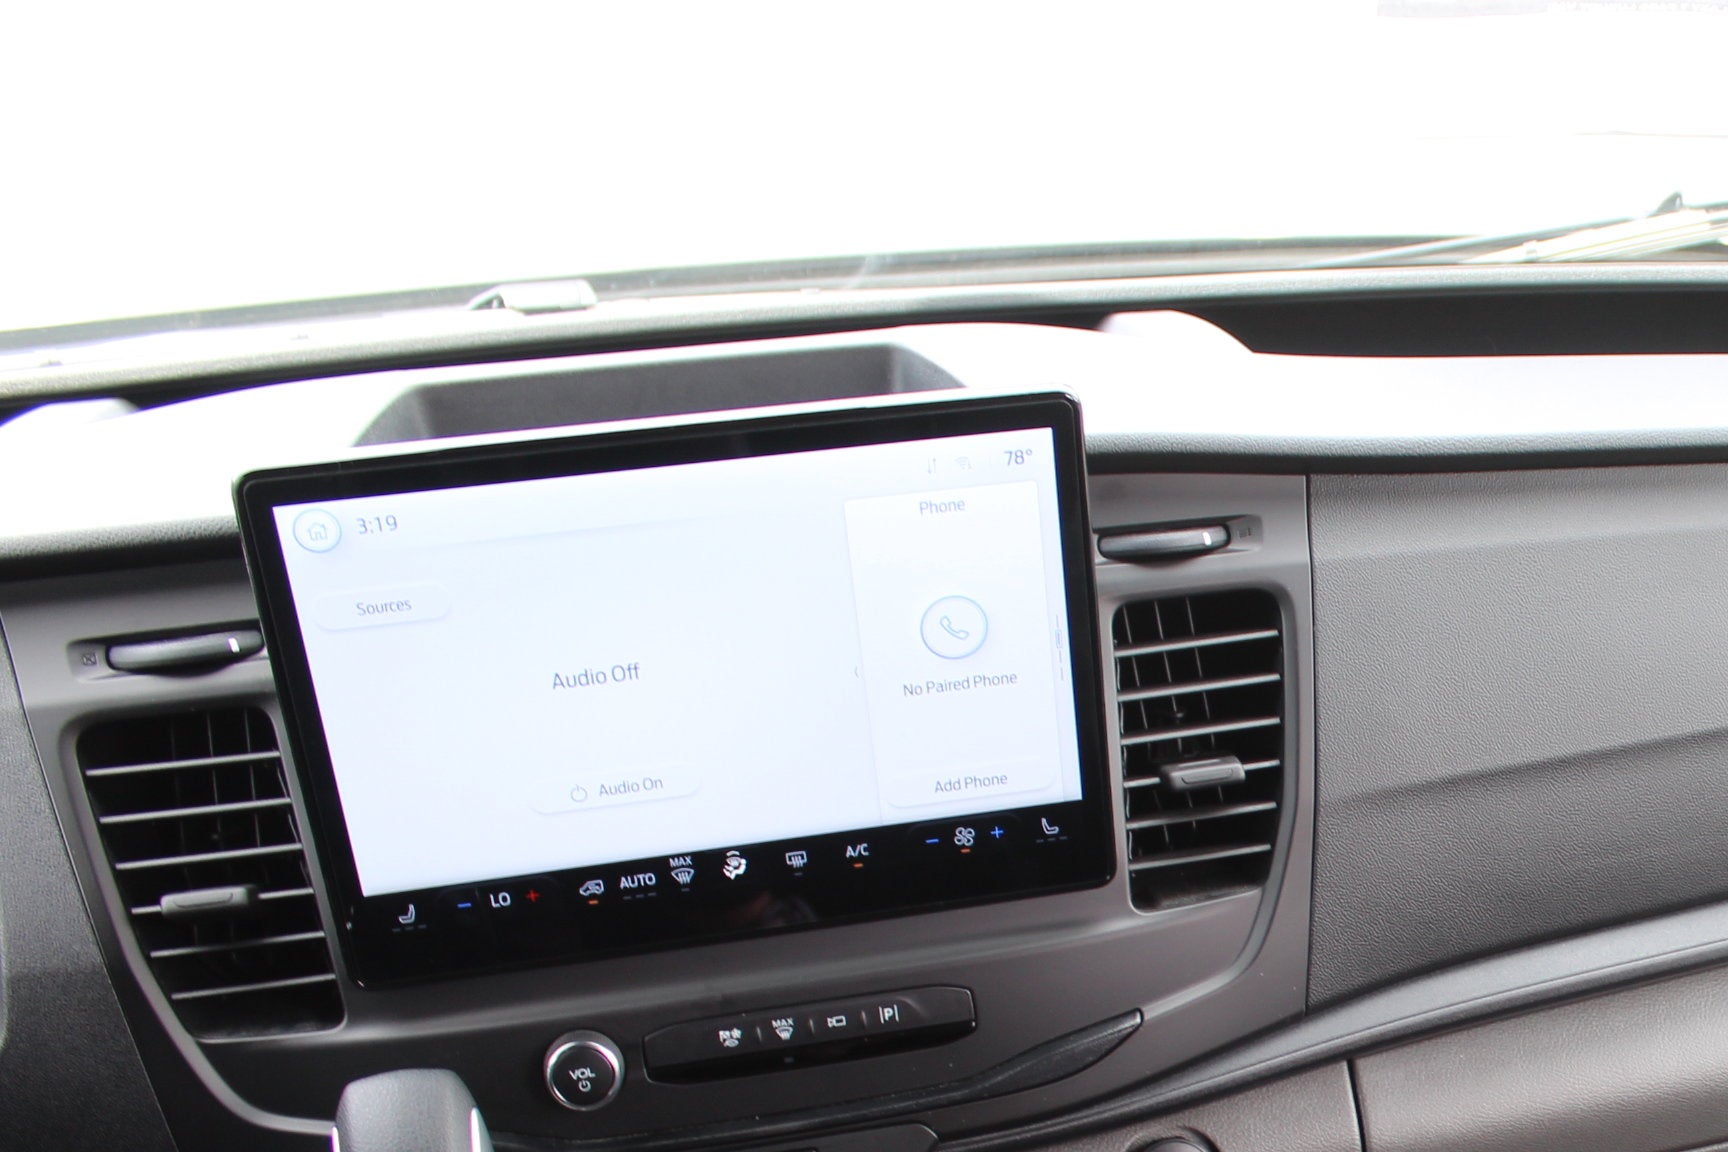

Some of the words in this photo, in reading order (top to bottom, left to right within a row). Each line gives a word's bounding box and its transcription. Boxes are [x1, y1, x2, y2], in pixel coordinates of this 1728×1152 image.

[919, 500, 966, 515] Phone
[356, 514, 398, 534] 3:19
[356, 600, 413, 616] Sources
[552, 668, 607, 690] Audio
[611, 662, 640, 682] Off
[903, 683, 923, 696] No
[926, 676, 971, 694] Paired
[973, 672, 1018, 688] Phone
[598, 780, 640, 797] Audio
[642, 777, 664, 791] On
[934, 779, 962, 793] Add
[964, 773, 1008, 789] Phone
[845, 843, 870, 858] A/C
[669, 855, 693, 868] MAX
[619, 872, 656, 890] AUTO
[489, 892, 512, 909] LO
[771, 1017, 795, 1028] MAX
[568, 1066, 597, 1081] VOL
